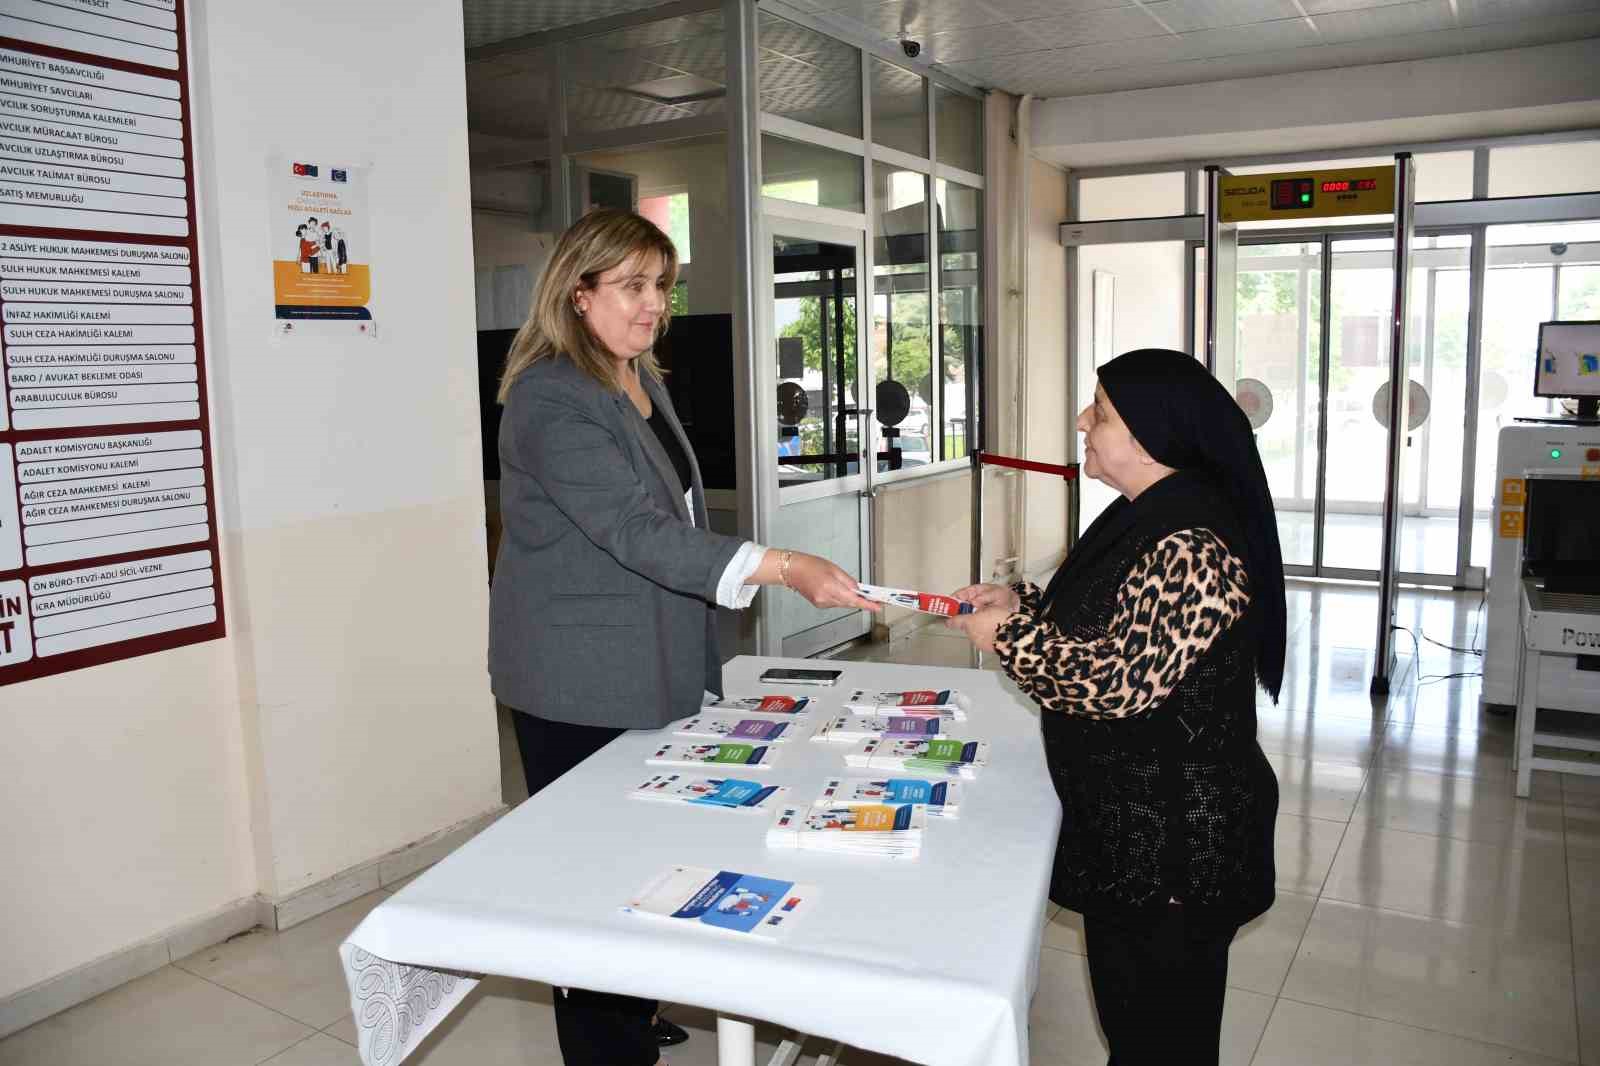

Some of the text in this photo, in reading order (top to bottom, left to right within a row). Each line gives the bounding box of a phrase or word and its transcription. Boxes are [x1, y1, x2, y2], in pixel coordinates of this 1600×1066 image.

[50, 87, 93, 100] SAVCILARI
[31, 103, 91, 120] SORUŞTURMA
[93, 113, 136, 127] KALEMLERİ
[85, 133, 118, 145] BÜROSU
[35, 148, 88, 161] UZLAŞTIRMA
[91, 153, 124, 165] BÜROSU
[38, 169, 74, 181] TALİMAT
[77, 173, 110, 184] BÜROSU
[26, 191, 84, 203] MEMURLUĞU
[9, 243, 38, 252] ASLİYE
[39, 245, 69, 254] HUKUK
[71, 247, 119, 257] MAHKEMESİ
[121, 249, 159, 260] DURUŞMA
[160, 251, 189, 261] SALONU
[1, 264, 141, 278] SULH HUKUK MAHKEMESİ KALEMİ
[2, 286, 184, 300] SULH HUKUK MAHKEMESİ DURUŞMA SALONU
[6, 309, 32, 319] İNFAZ
[80, 310, 111, 320] KALEMİ
[10, 329, 33, 338] SULH
[35, 329, 56, 338] CEZA
[103, 328, 133, 338] KALEMİ
[9, 354, 33, 364] SULH
[35, 354, 56, 363] CEZA
[103, 352, 143, 363] DURUŞMA
[145, 352, 175, 361] SALONU
[12, 373, 36, 383] BARO
[45, 372, 79, 382] AVUKAT
[81, 371, 117, 381] BEKLEME
[119, 370, 143, 380] ODASI
[15, 389, 118, 403] ARABULUCULUK BÜROSU
[20, 437, 152, 456] ADALET KOMİSYONU BAŞKANLIĞI
[23, 458, 139, 477] ADALET KOMİSYONU KALEMİ
[24, 479, 151, 500] AĞIR CEZA MAHKEMESİ KALEMİ
[25, 491, 191, 519] AĞIR CEZA MAHKEMESİ DURUŞMA SALONU
[35, 592, 111, 612] İCRA MÜDÜRLÜĞÜ
[0, 621, 15, 655] T
